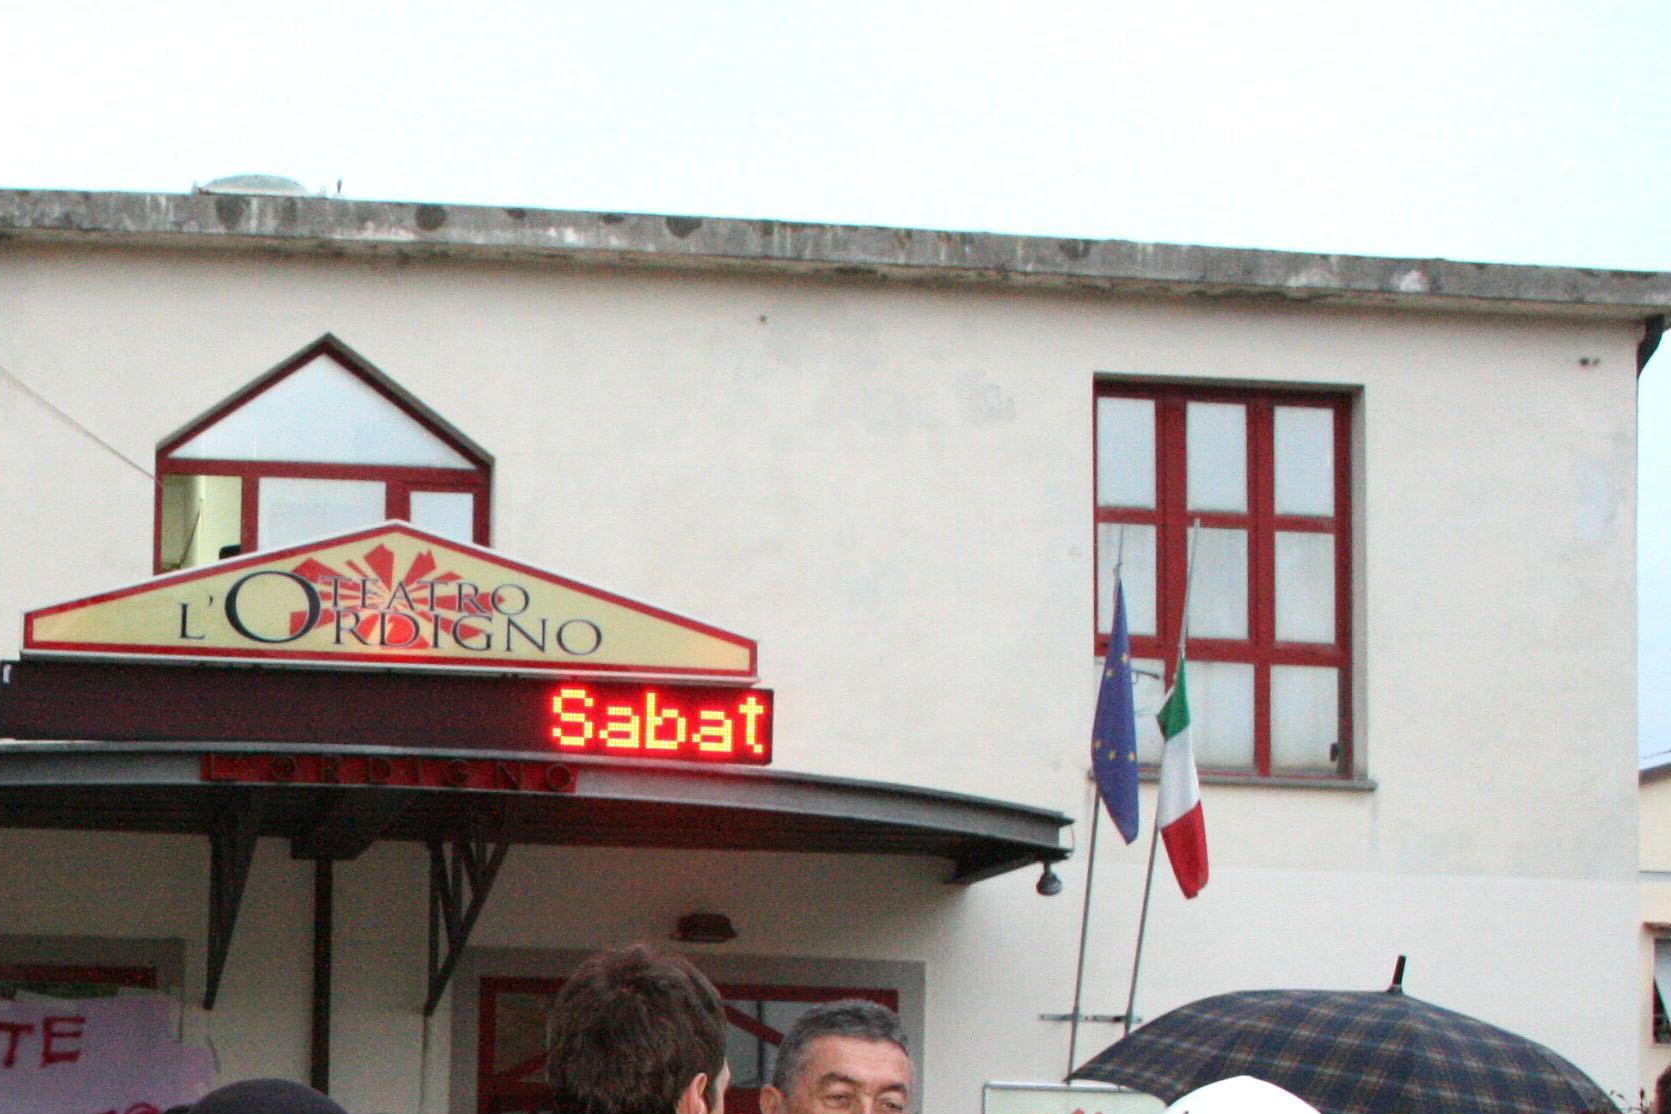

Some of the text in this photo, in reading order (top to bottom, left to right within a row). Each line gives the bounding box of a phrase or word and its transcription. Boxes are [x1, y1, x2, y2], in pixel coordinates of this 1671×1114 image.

[179, 570, 603, 656] L'ORDIGNO
[320, 575, 530, 616] TEATRO
[551, 688, 765, 755] Sabat
